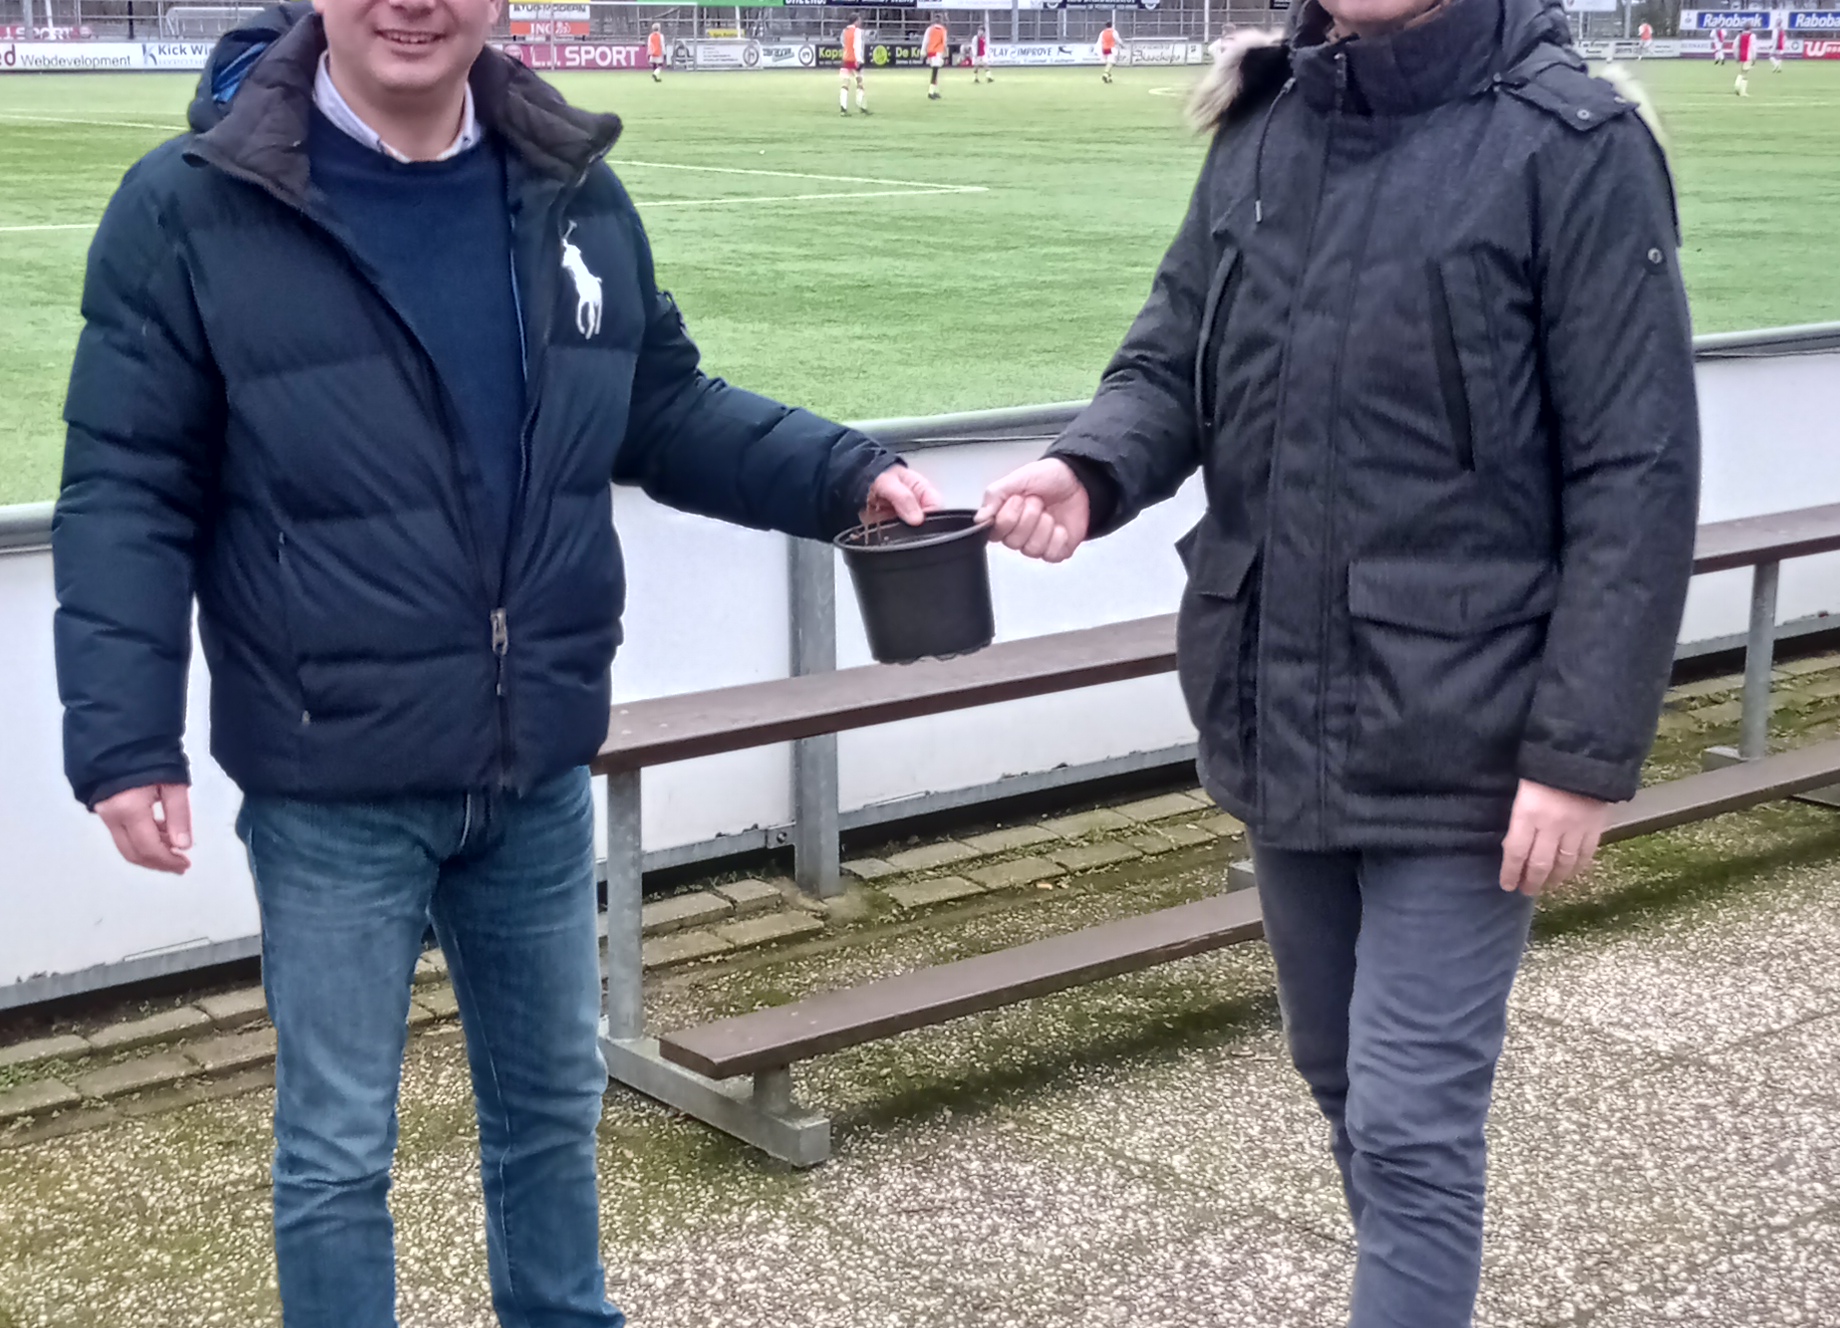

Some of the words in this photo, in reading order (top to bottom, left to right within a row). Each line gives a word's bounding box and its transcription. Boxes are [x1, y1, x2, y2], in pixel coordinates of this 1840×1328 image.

[158, 44, 187, 56] Kick
[565, 46, 639, 67] SPORT
[20, 54, 131, 69] Webdevelopment
